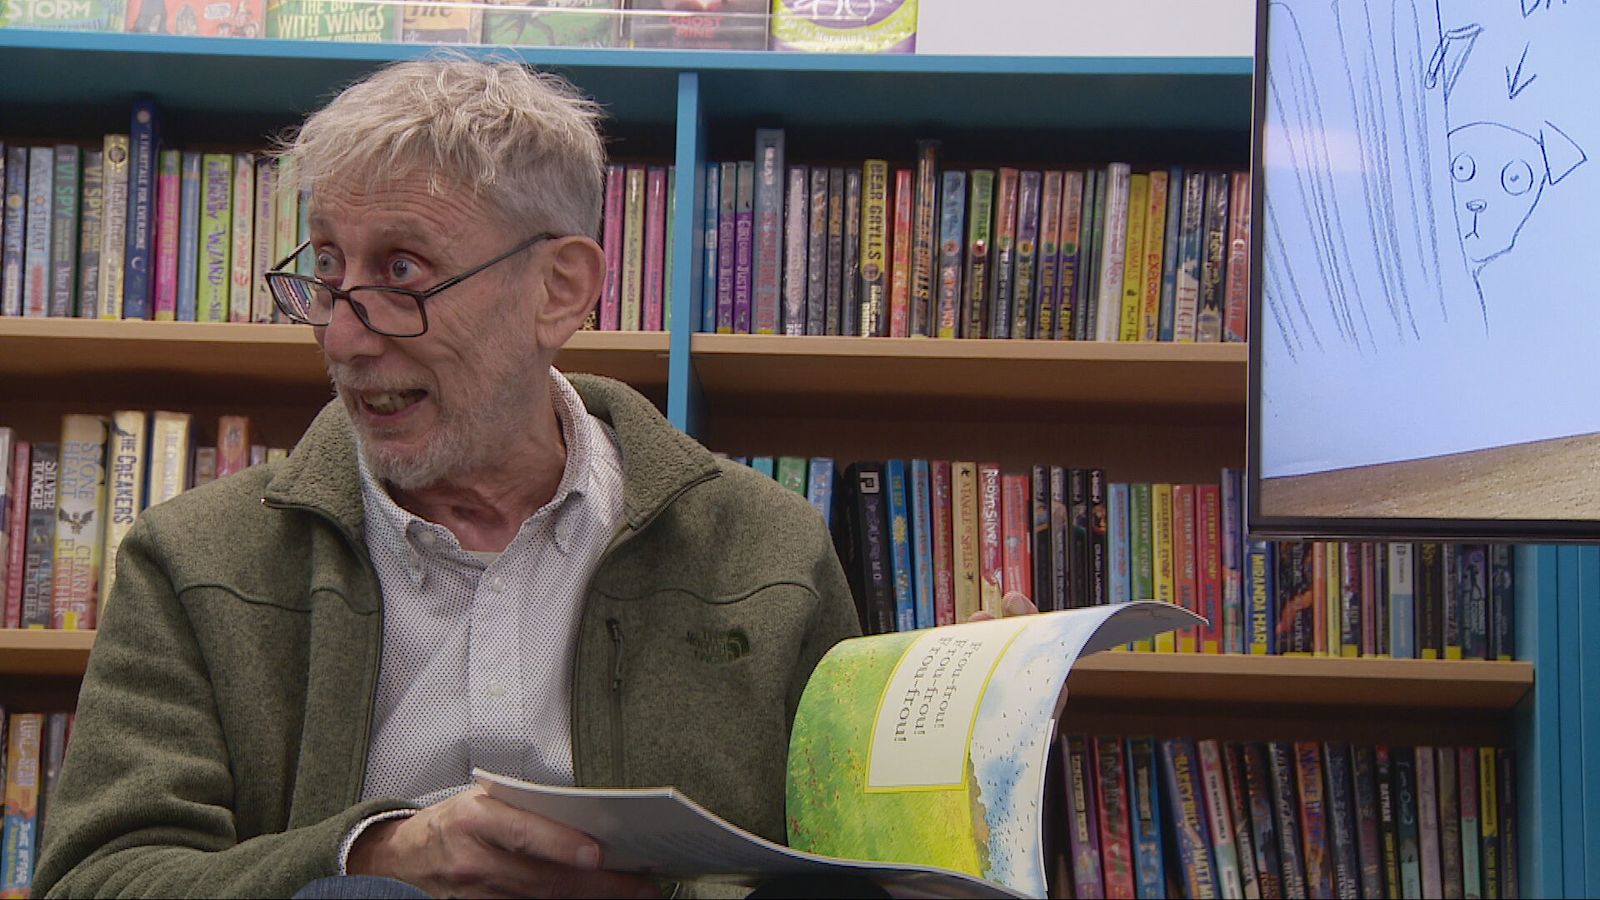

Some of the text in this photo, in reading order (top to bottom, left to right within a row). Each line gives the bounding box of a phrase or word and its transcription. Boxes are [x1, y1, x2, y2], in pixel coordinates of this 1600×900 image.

[8, 0, 91, 21] STORM
[278, 5, 384, 39] WITH WINGS
[675, 26, 715, 38] MINE
[56, 184, 74, 216] SPY
[84, 186, 101, 218] SPY
[136, 204, 147, 248] EVERYONE
[868, 164, 883, 260] BEAR GRYLLS
[736, 266, 750, 305] JUSTICE
[1178, 288, 1197, 342] FLIGH
[31, 460, 44, 509] TONGUE
[44, 461, 57, 509] SILVER
[61, 441, 80, 498] HEART
[79, 443, 98, 499] STONE
[113, 434, 137, 524] THE CREAKERS
[984, 469, 998, 545] Robyn Silver
[24, 553, 40, 619] FLETCHER
[38, 559, 51, 615] CHARLIE
[54, 538, 75, 617] FLETCHER
[73, 546, 92, 613] CHARLIE
[1251, 555, 1267, 645] MIRANDA HAR
[893, 637, 953, 742] Frou-frou!
[913, 639, 968, 736] Frou-frou!
[934, 641, 982, 730] Frou-frou!
[1380, 783, 1391, 821] BATMAN
[1193, 848, 1211, 883] MATT
